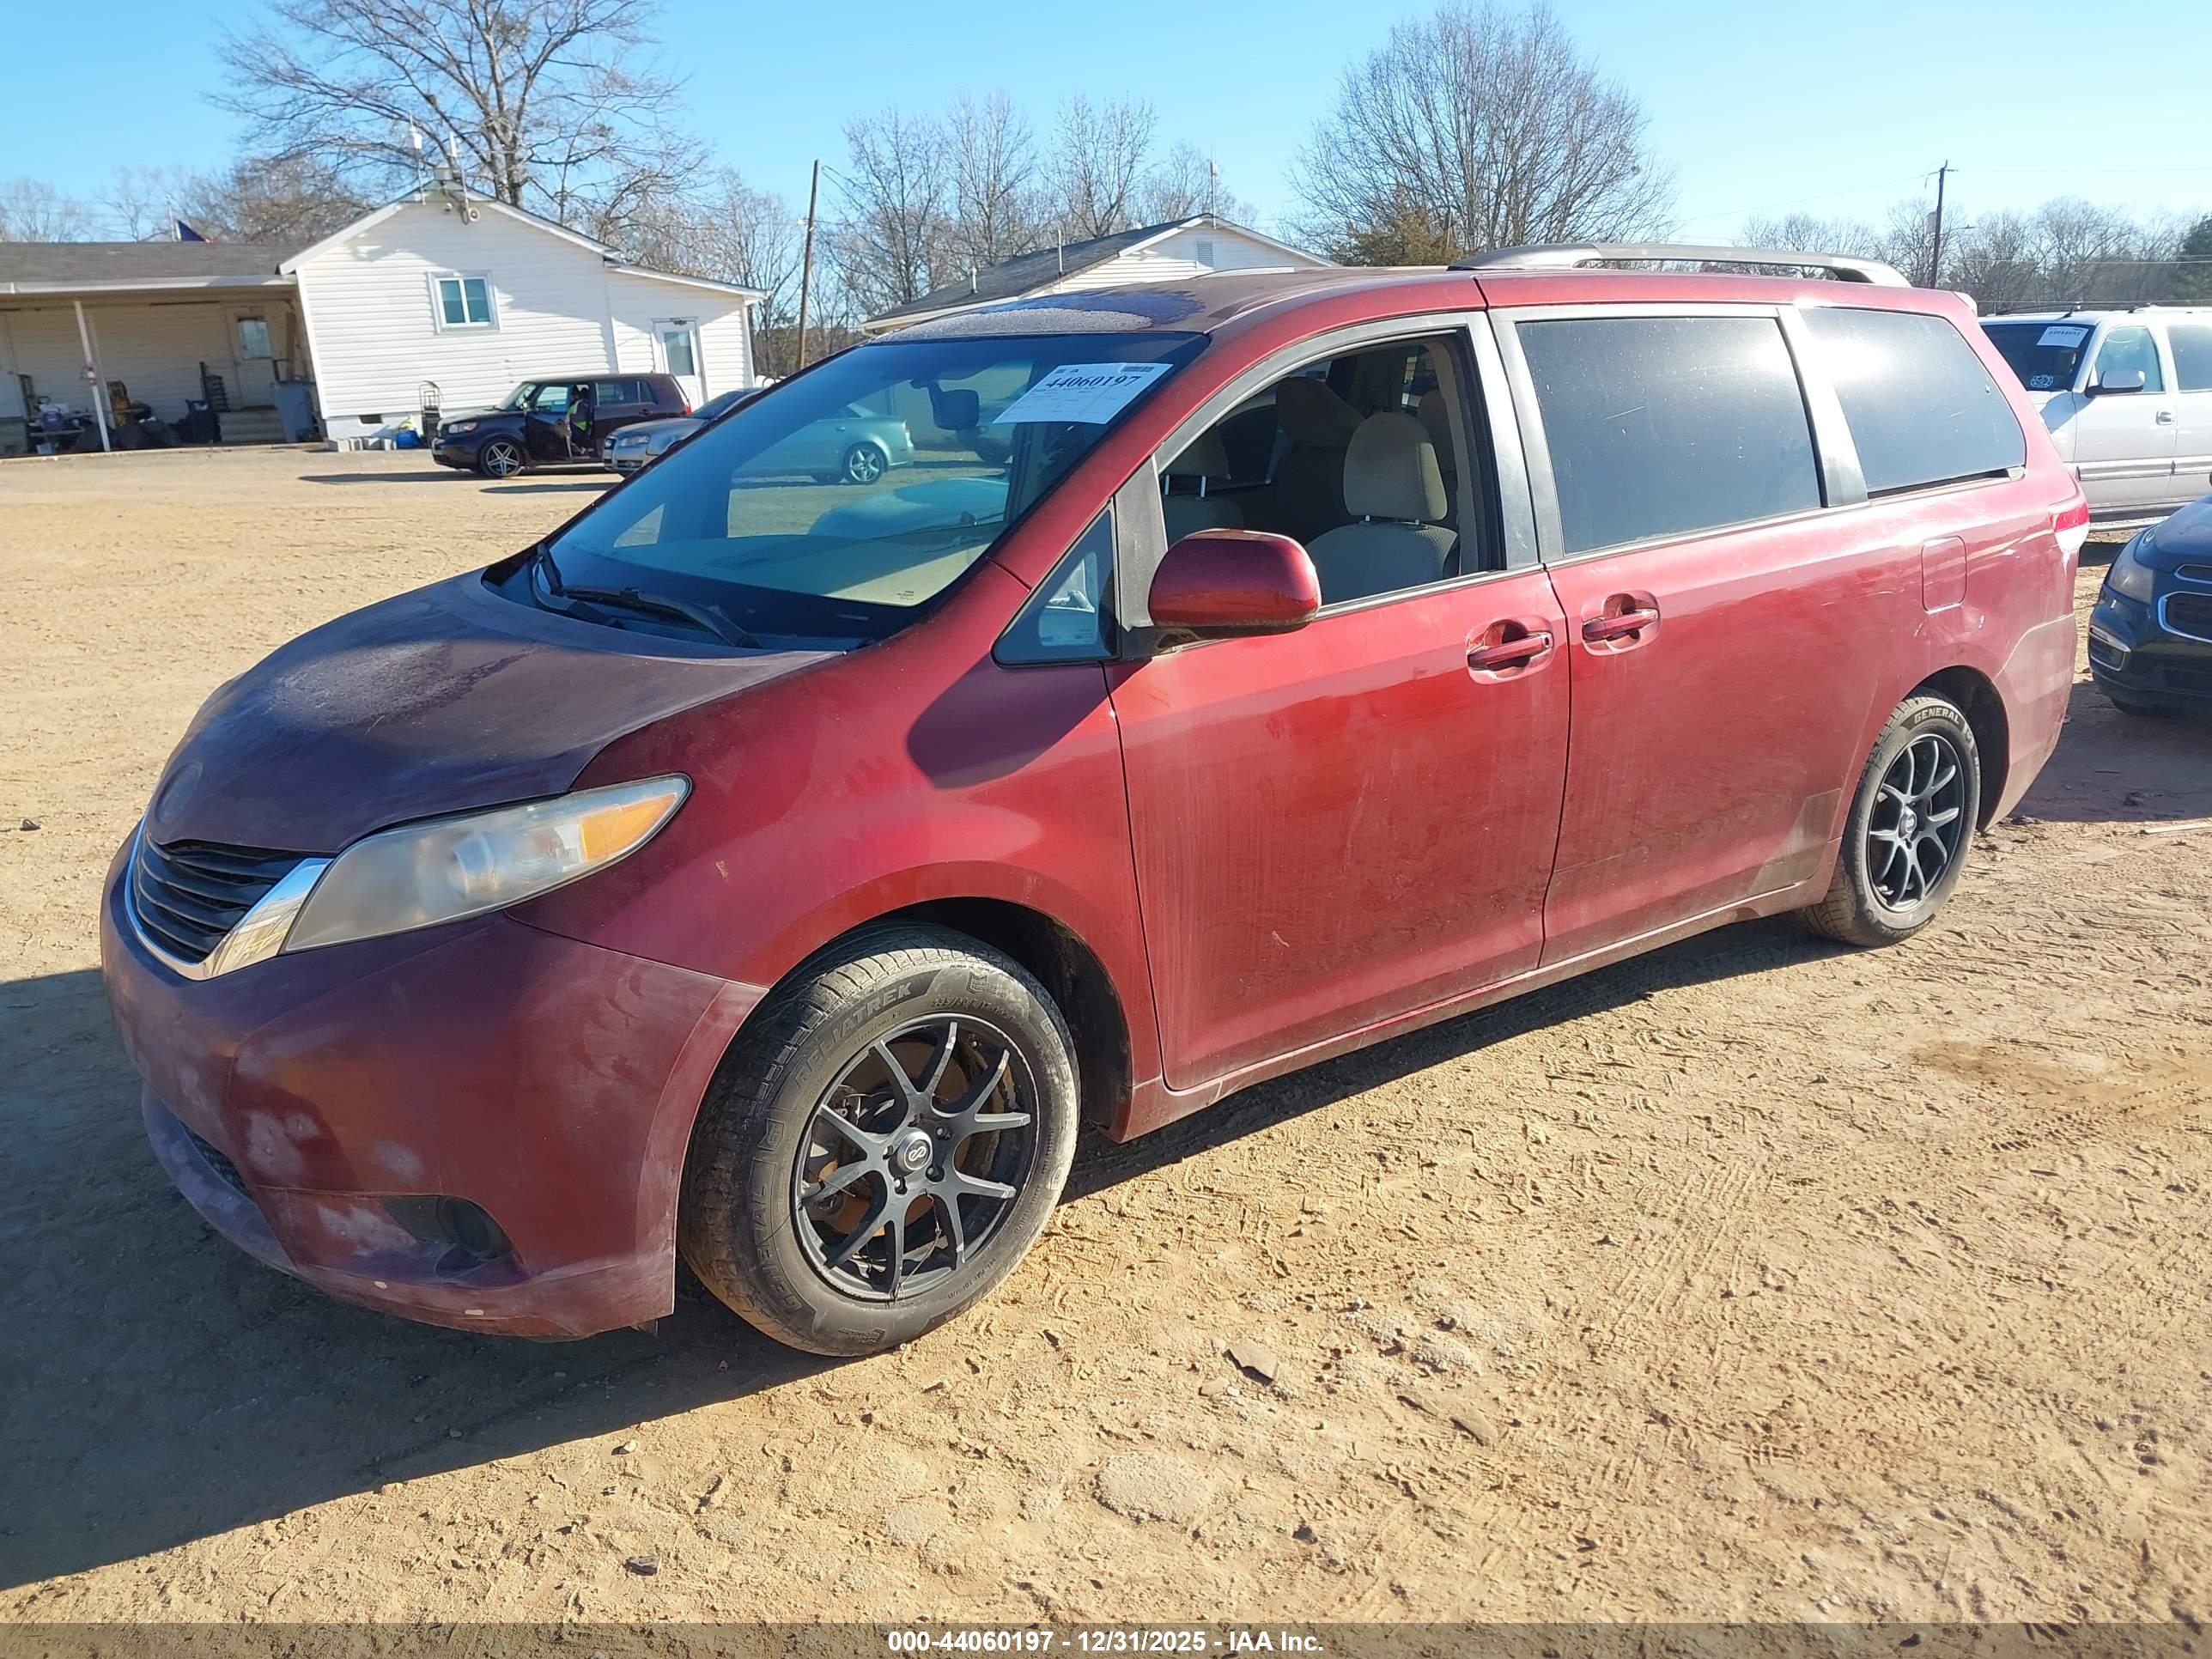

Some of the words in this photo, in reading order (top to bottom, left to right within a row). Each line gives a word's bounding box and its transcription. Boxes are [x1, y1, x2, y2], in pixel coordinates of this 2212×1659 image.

[1046, 375, 1138, 387] 44060197
[1913, 707, 1960, 726] GENERAL
[795, 982, 912, 1088] RELIATREK
